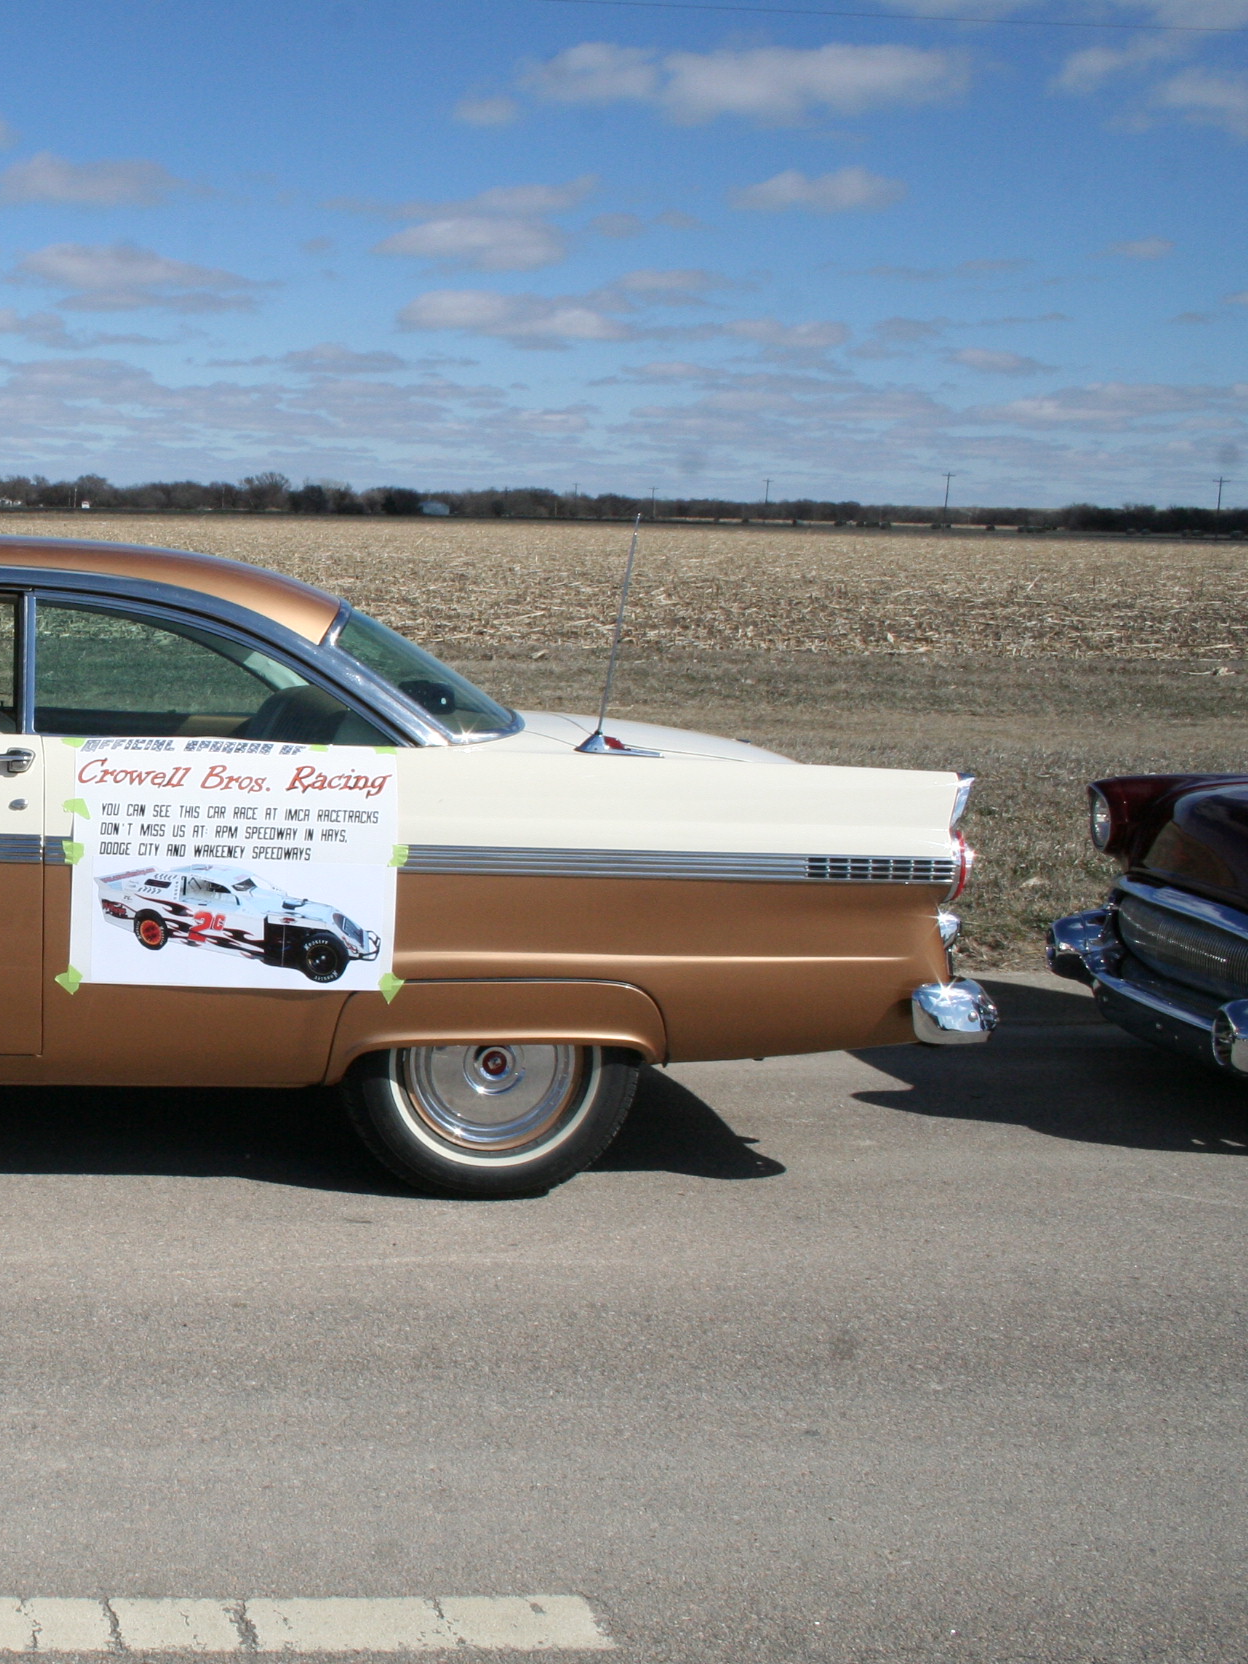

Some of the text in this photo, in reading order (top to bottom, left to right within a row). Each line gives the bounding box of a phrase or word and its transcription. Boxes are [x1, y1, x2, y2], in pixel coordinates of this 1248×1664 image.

[78, 757, 393, 799] Crowell Bros. Racing
[101, 802, 380, 824] YOU CAN SEE THIS CAR RACE AT IMCA RACETRACKS
[99, 821, 134, 836] DON'T
[139, 823, 166, 838] MISS
[172, 824, 187, 838] US
[214, 825, 239, 839] RPM
[244, 826, 299, 841] SPEEDWAY
[303, 828, 315, 842] IN
[98, 841, 312, 861] DODGE CITY AND WAKEENEY SPEEDWAYS
